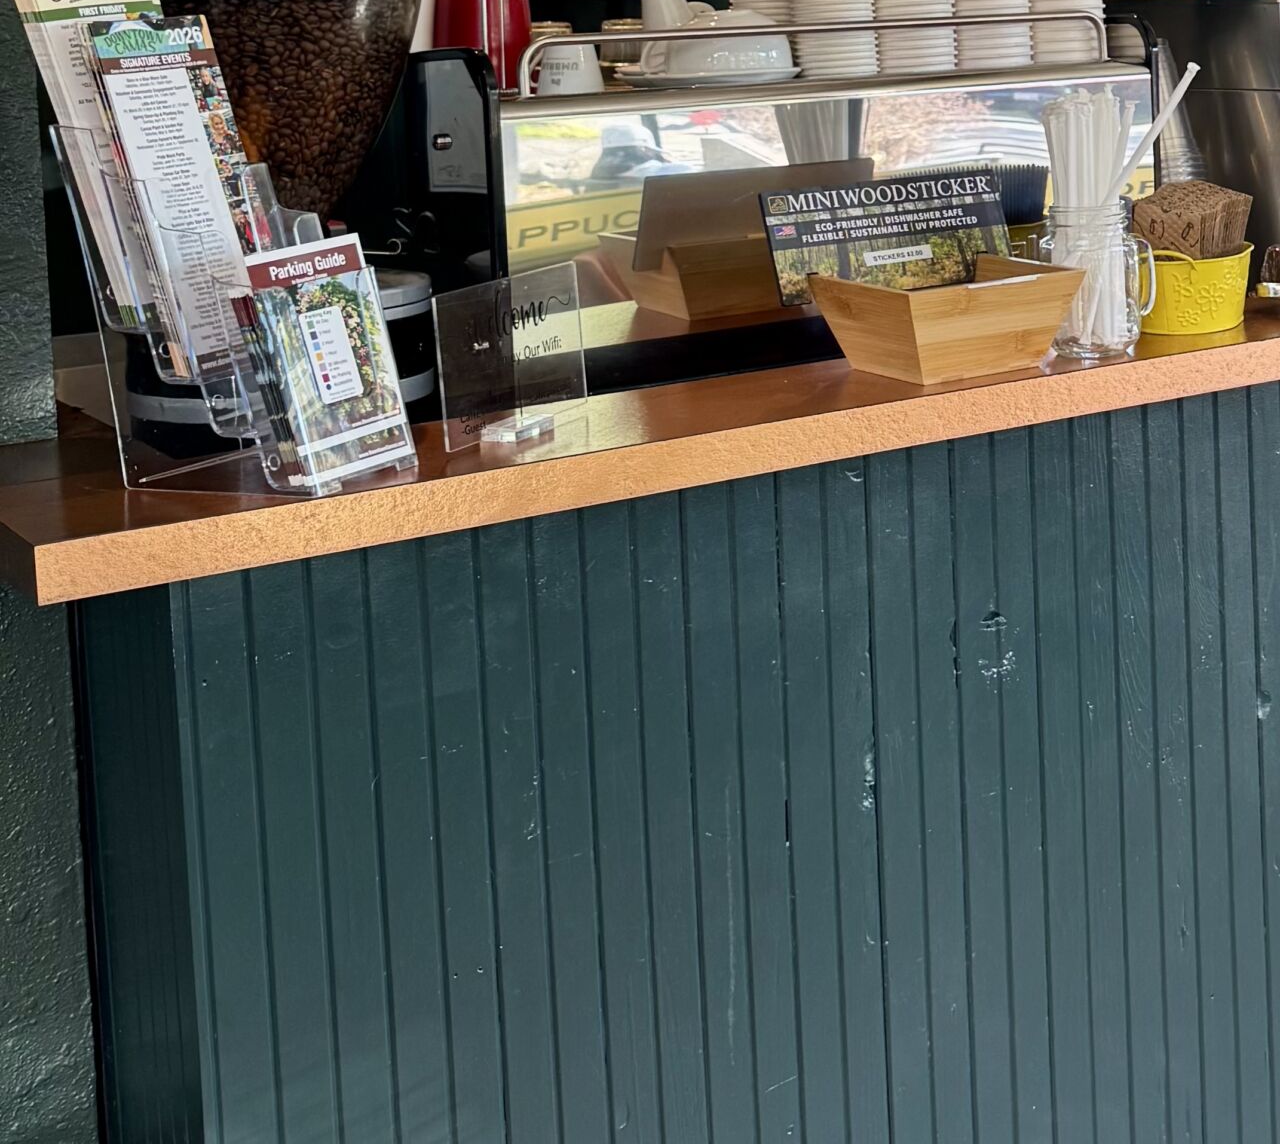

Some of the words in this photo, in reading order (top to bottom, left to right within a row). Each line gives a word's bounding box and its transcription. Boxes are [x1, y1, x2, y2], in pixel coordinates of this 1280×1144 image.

[103, 28, 165, 48] DOWNTOWN
[114, 41, 157, 55] CAMAS
[165, 26, 203, 46] 2026
[120, 55, 162, 69] SIGNATURE
[162, 52, 192, 65] EVENTS
[801, 231, 845, 244] FLEXIBLE
[850, 223, 909, 238] SUSTAINABLE
[915, 222, 928, 231] UV
[929, 215, 978, 229] PROTECTED
[815, 217, 878, 232] ECO-FRIENDLY
[885, 210, 941, 224] DISHWASHER
[942, 207, 964, 217] SAFE
[269, 261, 314, 281] Parking
[315, 252, 346, 271] Guide
[523, 344, 540, 358] Our
